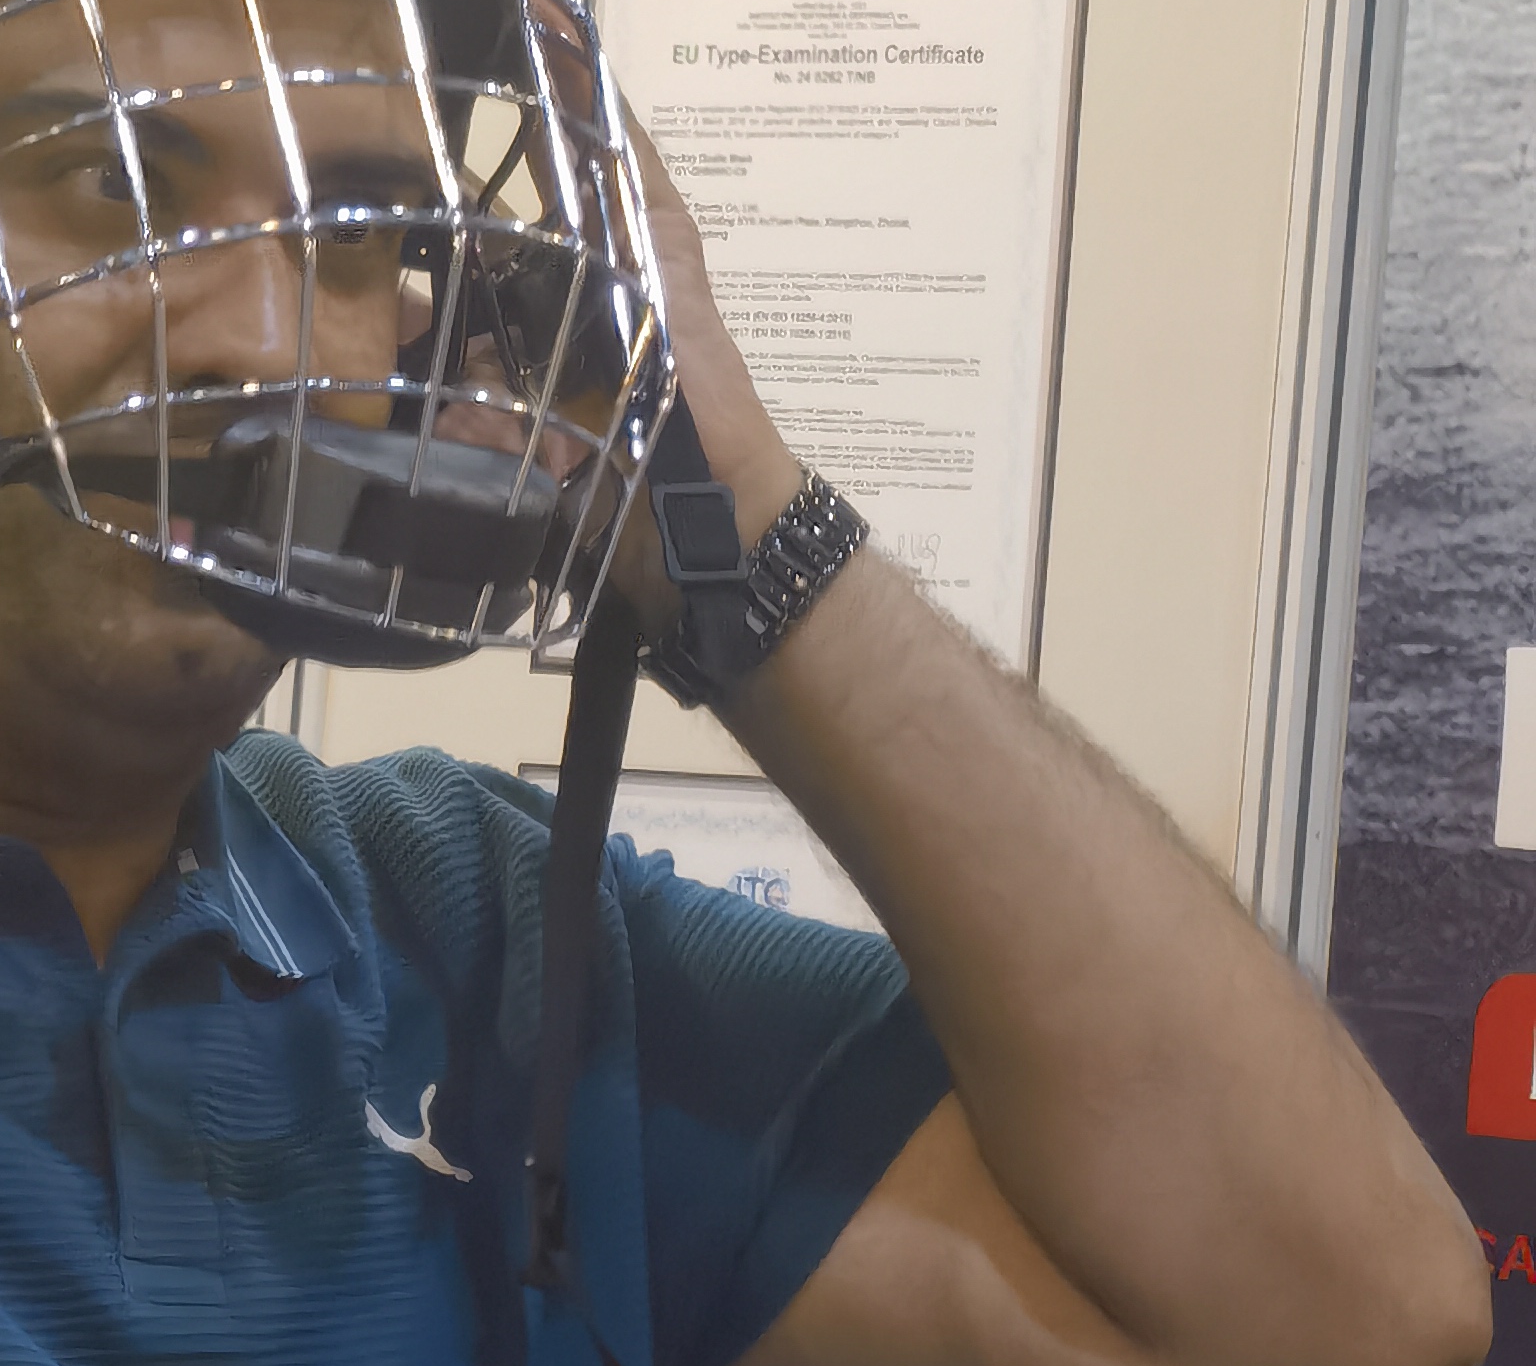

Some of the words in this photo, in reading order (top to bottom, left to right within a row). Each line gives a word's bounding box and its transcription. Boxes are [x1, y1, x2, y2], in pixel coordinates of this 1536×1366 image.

[672, 44, 700, 66] EU
[706, 43, 878, 70] Type-Examination
[884, 44, 986, 66] Certificate
